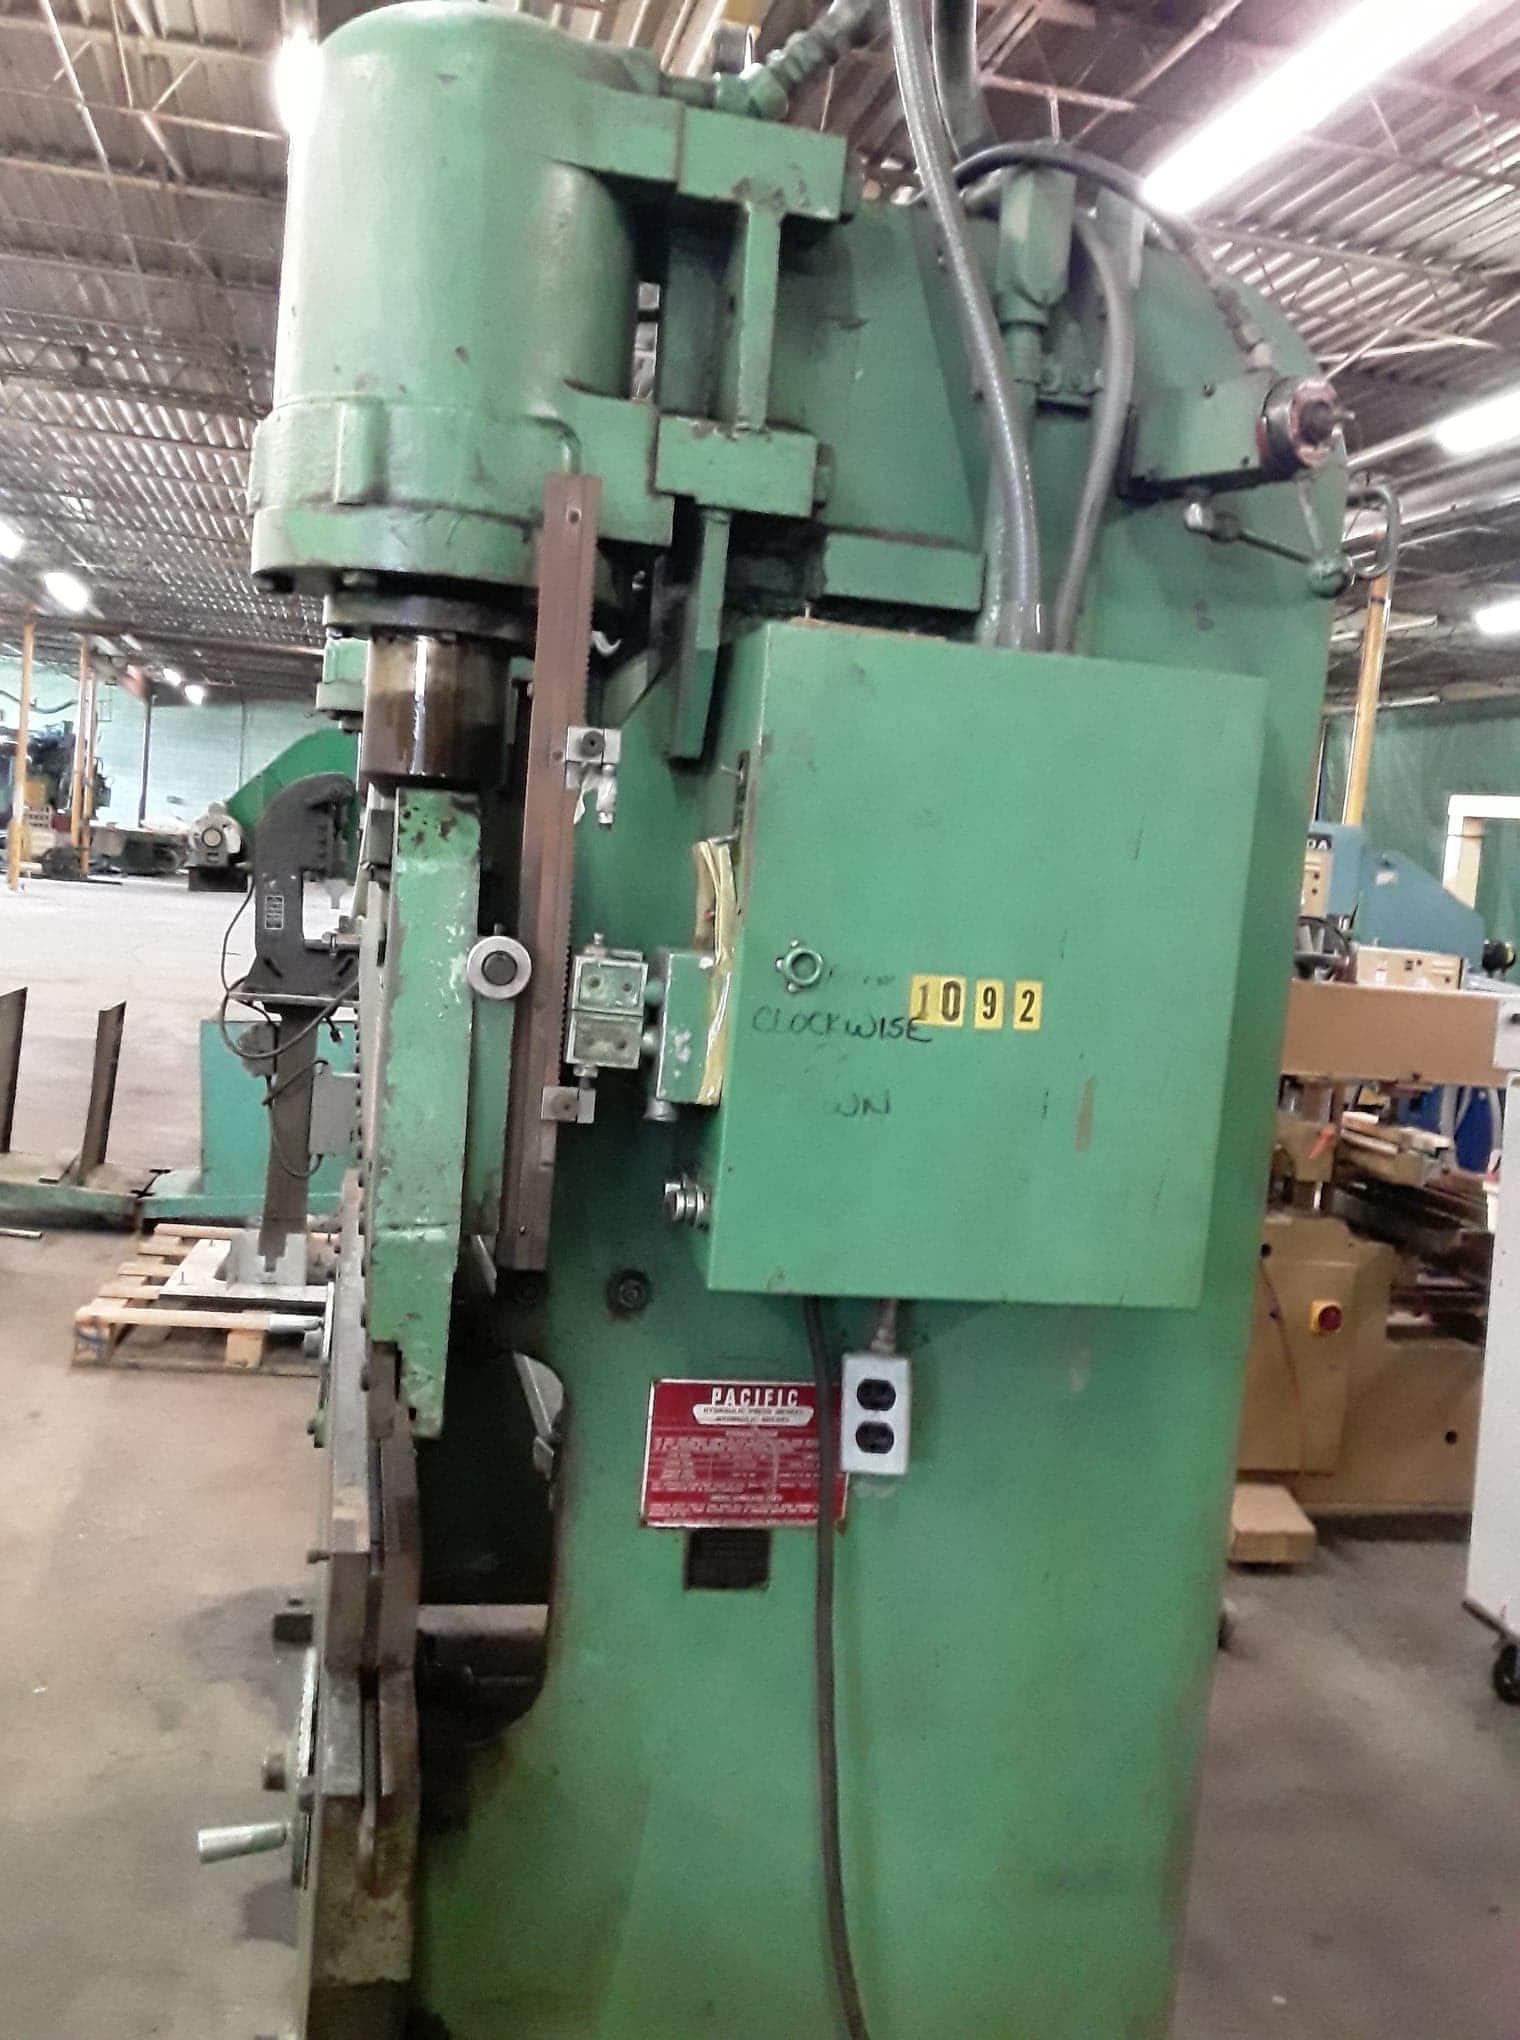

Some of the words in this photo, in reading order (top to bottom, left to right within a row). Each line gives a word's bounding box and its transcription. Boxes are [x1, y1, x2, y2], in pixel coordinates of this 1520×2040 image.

[917, 980, 1036, 1022] 1092
[752, 1006, 933, 1042] CLOCKWISE
[711, 1387, 799, 1409] PACIFIC
